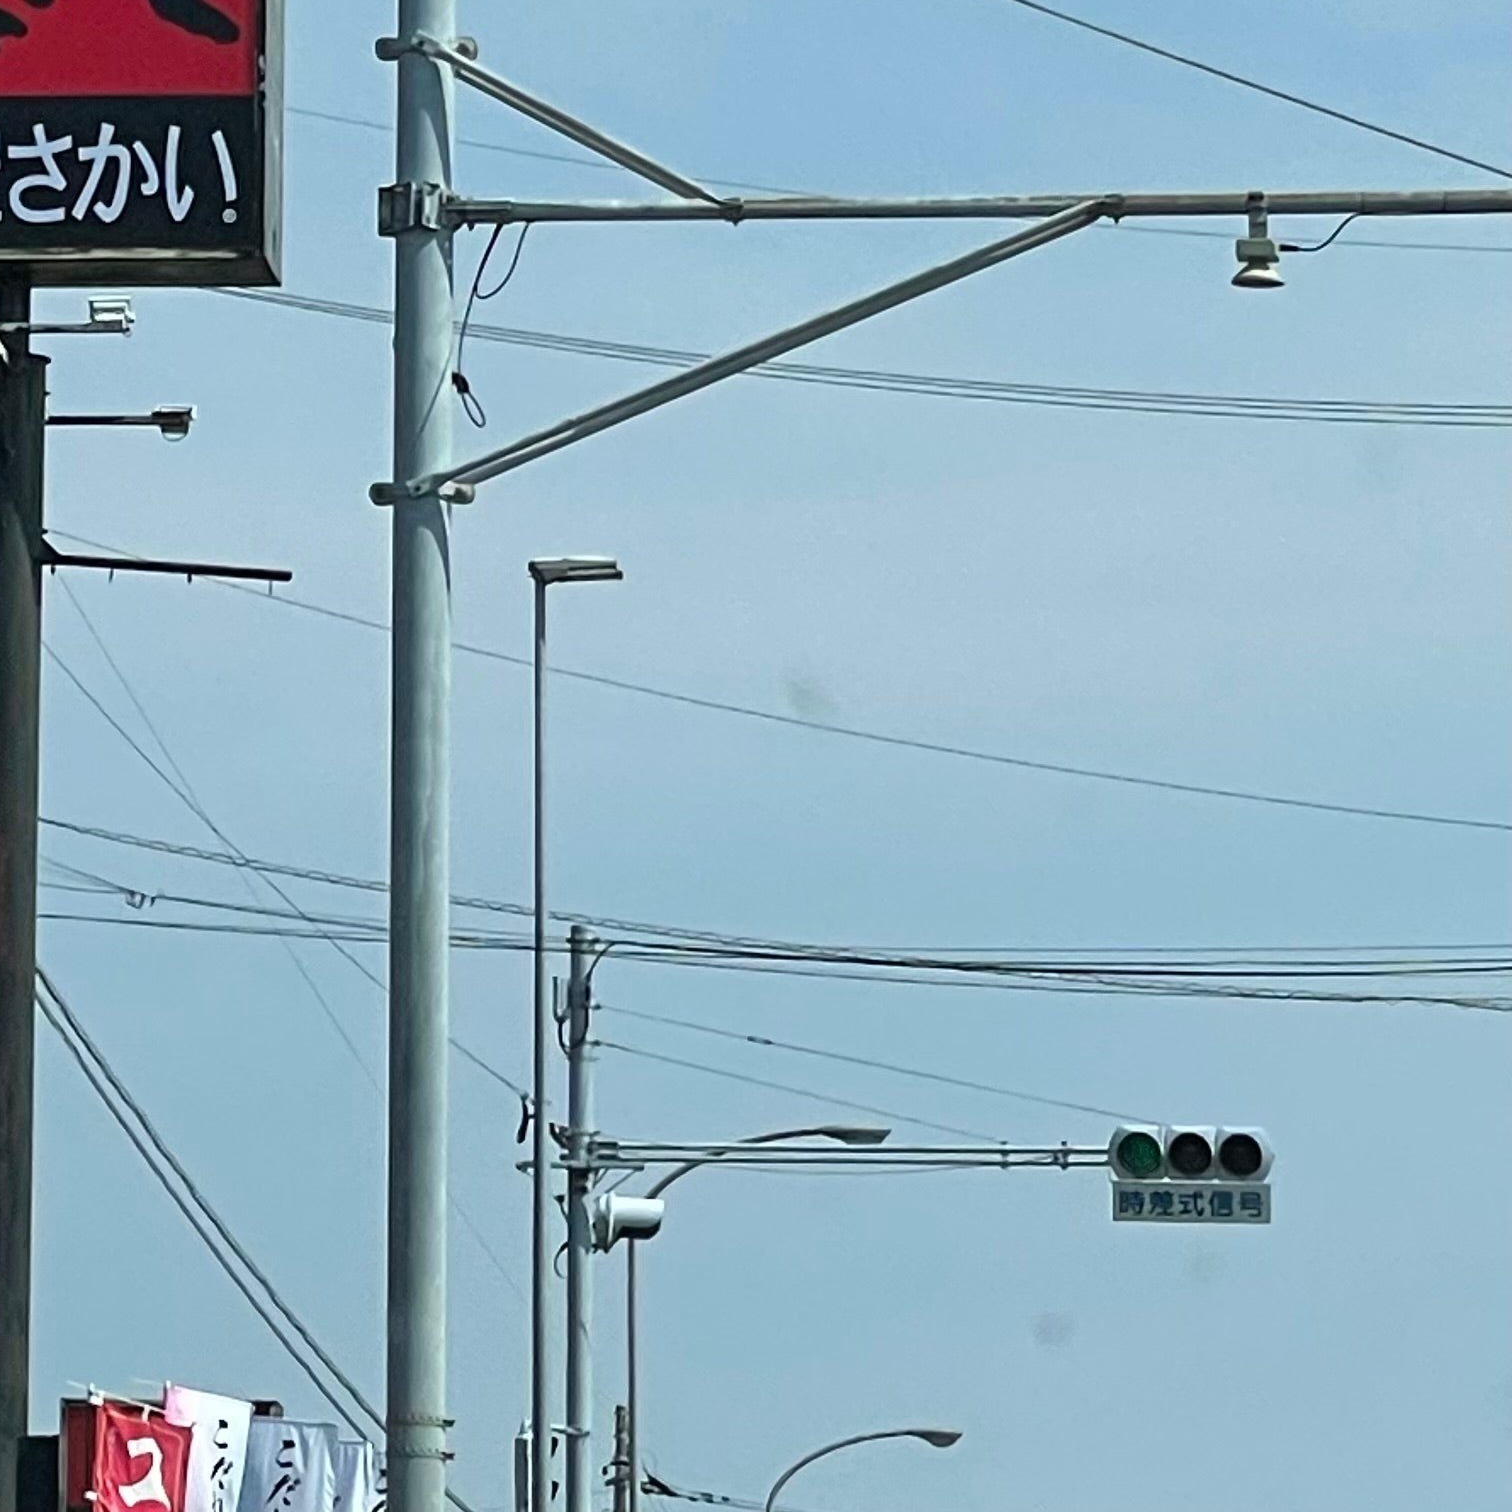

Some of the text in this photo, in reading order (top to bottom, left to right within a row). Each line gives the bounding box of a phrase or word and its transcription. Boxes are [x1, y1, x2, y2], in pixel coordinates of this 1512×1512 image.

[1118, 1190, 1263, 1218] 時差式信号
